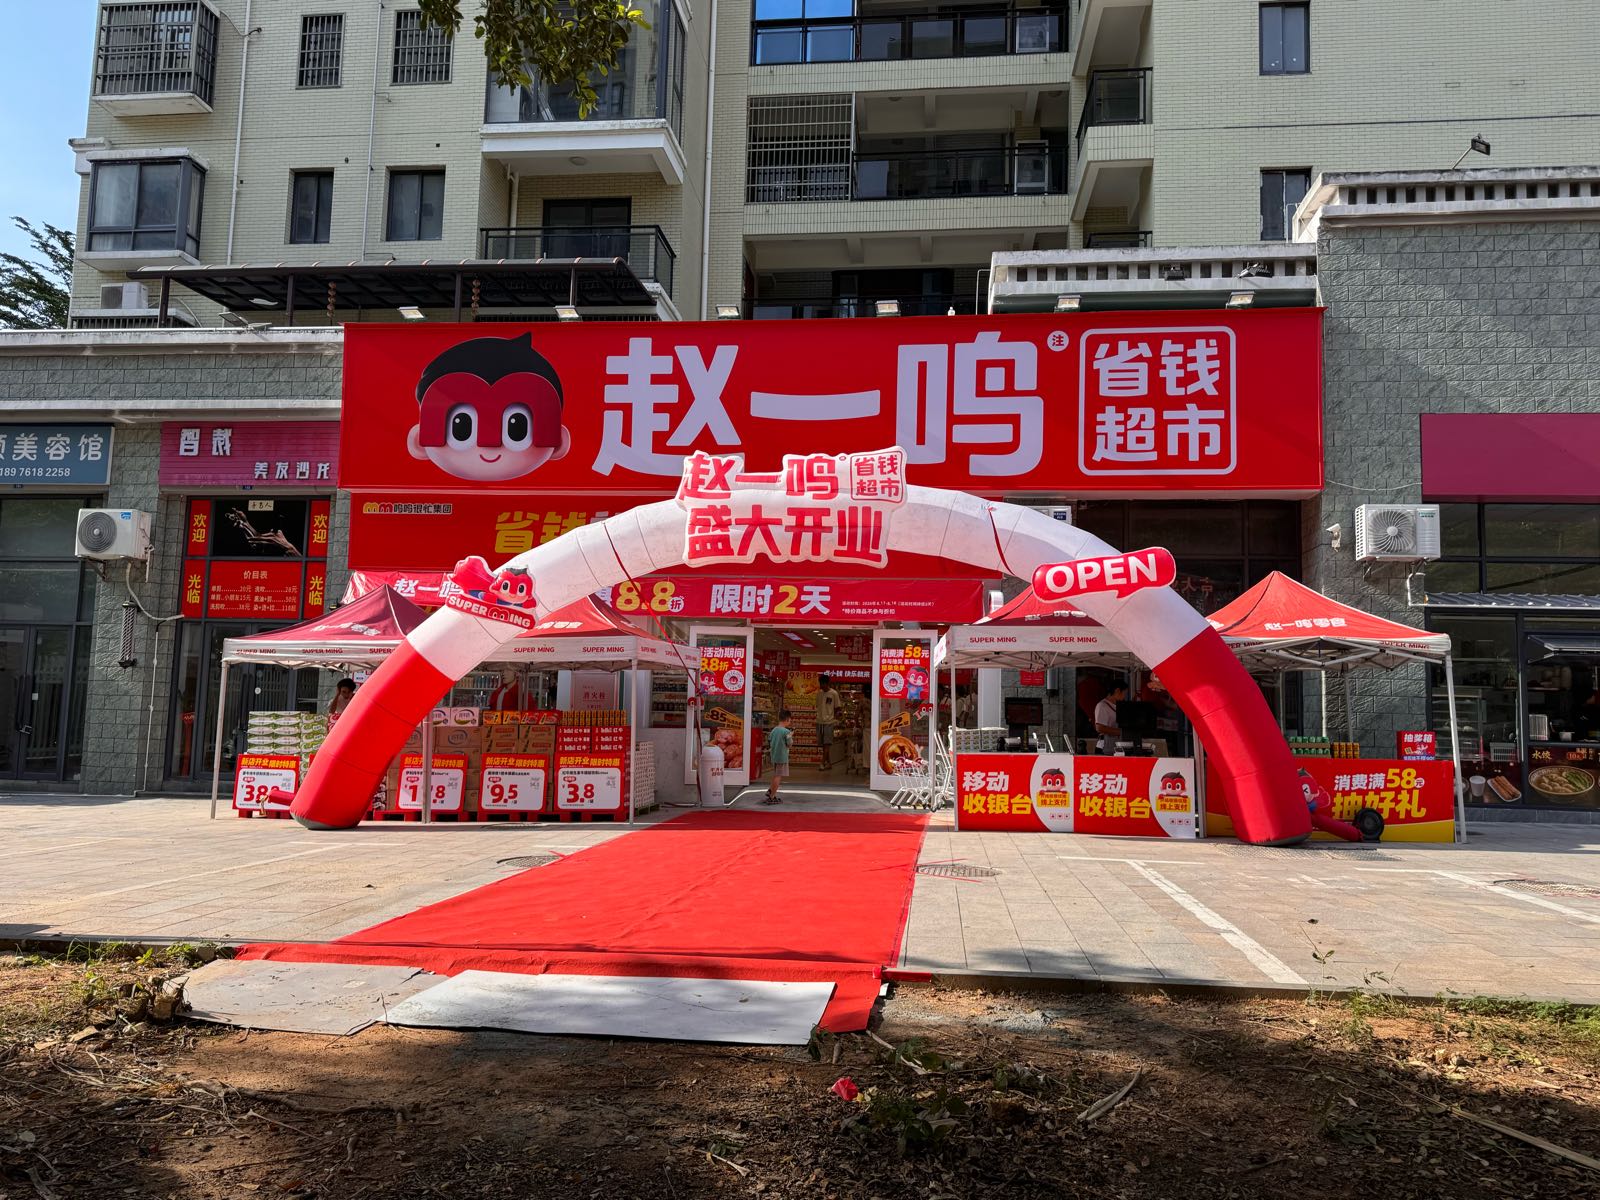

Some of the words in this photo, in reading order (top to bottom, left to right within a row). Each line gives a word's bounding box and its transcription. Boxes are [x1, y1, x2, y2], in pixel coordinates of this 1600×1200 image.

[1093, 339, 1221, 396] 省钱
[593, 332, 1044, 477] 赵一鸣
[1092, 403, 1225, 463] 超市
[20, 468, 43, 477] 7618
[46, 468, 71, 477] 2258
[855, 454, 898, 477] 省钱
[679, 454, 839, 501] 赵一鸣
[856, 478, 900, 498] 超市
[192, 513, 207, 543] 欢迎
[312, 514, 328, 544] 欢迎
[688, 504, 883, 564] 盛大开业
[243, 570, 268, 580] 价目表
[1045, 553, 1157, 594] OPEN
[186, 574, 201, 604] 光临
[308, 576, 324, 606] 光临
[709, 583, 831, 615] 限时2天
[448, 595, 488, 616] SUPER
[881, 646, 930, 658] 消费满58元
[888, 717, 903, 728] 72
[1404, 733, 1433, 743] 抽奖箱
[241, 757, 269, 767] 新店开业
[269, 760, 297, 768] 限时特惠
[486, 757, 515, 766] 新店开业
[515, 759, 545, 768] 限时特惠
[560, 757, 589, 765] 新店开业
[590, 758, 620, 767] 限时特惠
[962, 771, 1010, 792] 移动
[1079, 773, 1128, 795] 移动
[1333, 768, 1425, 791] 消费满58元
[409, 785, 446, 804] 1.8
[962, 793, 1033, 815] 收银台
[1331, 789, 1427, 820] 抽好礼
[1079, 796, 1151, 819] 收银台
